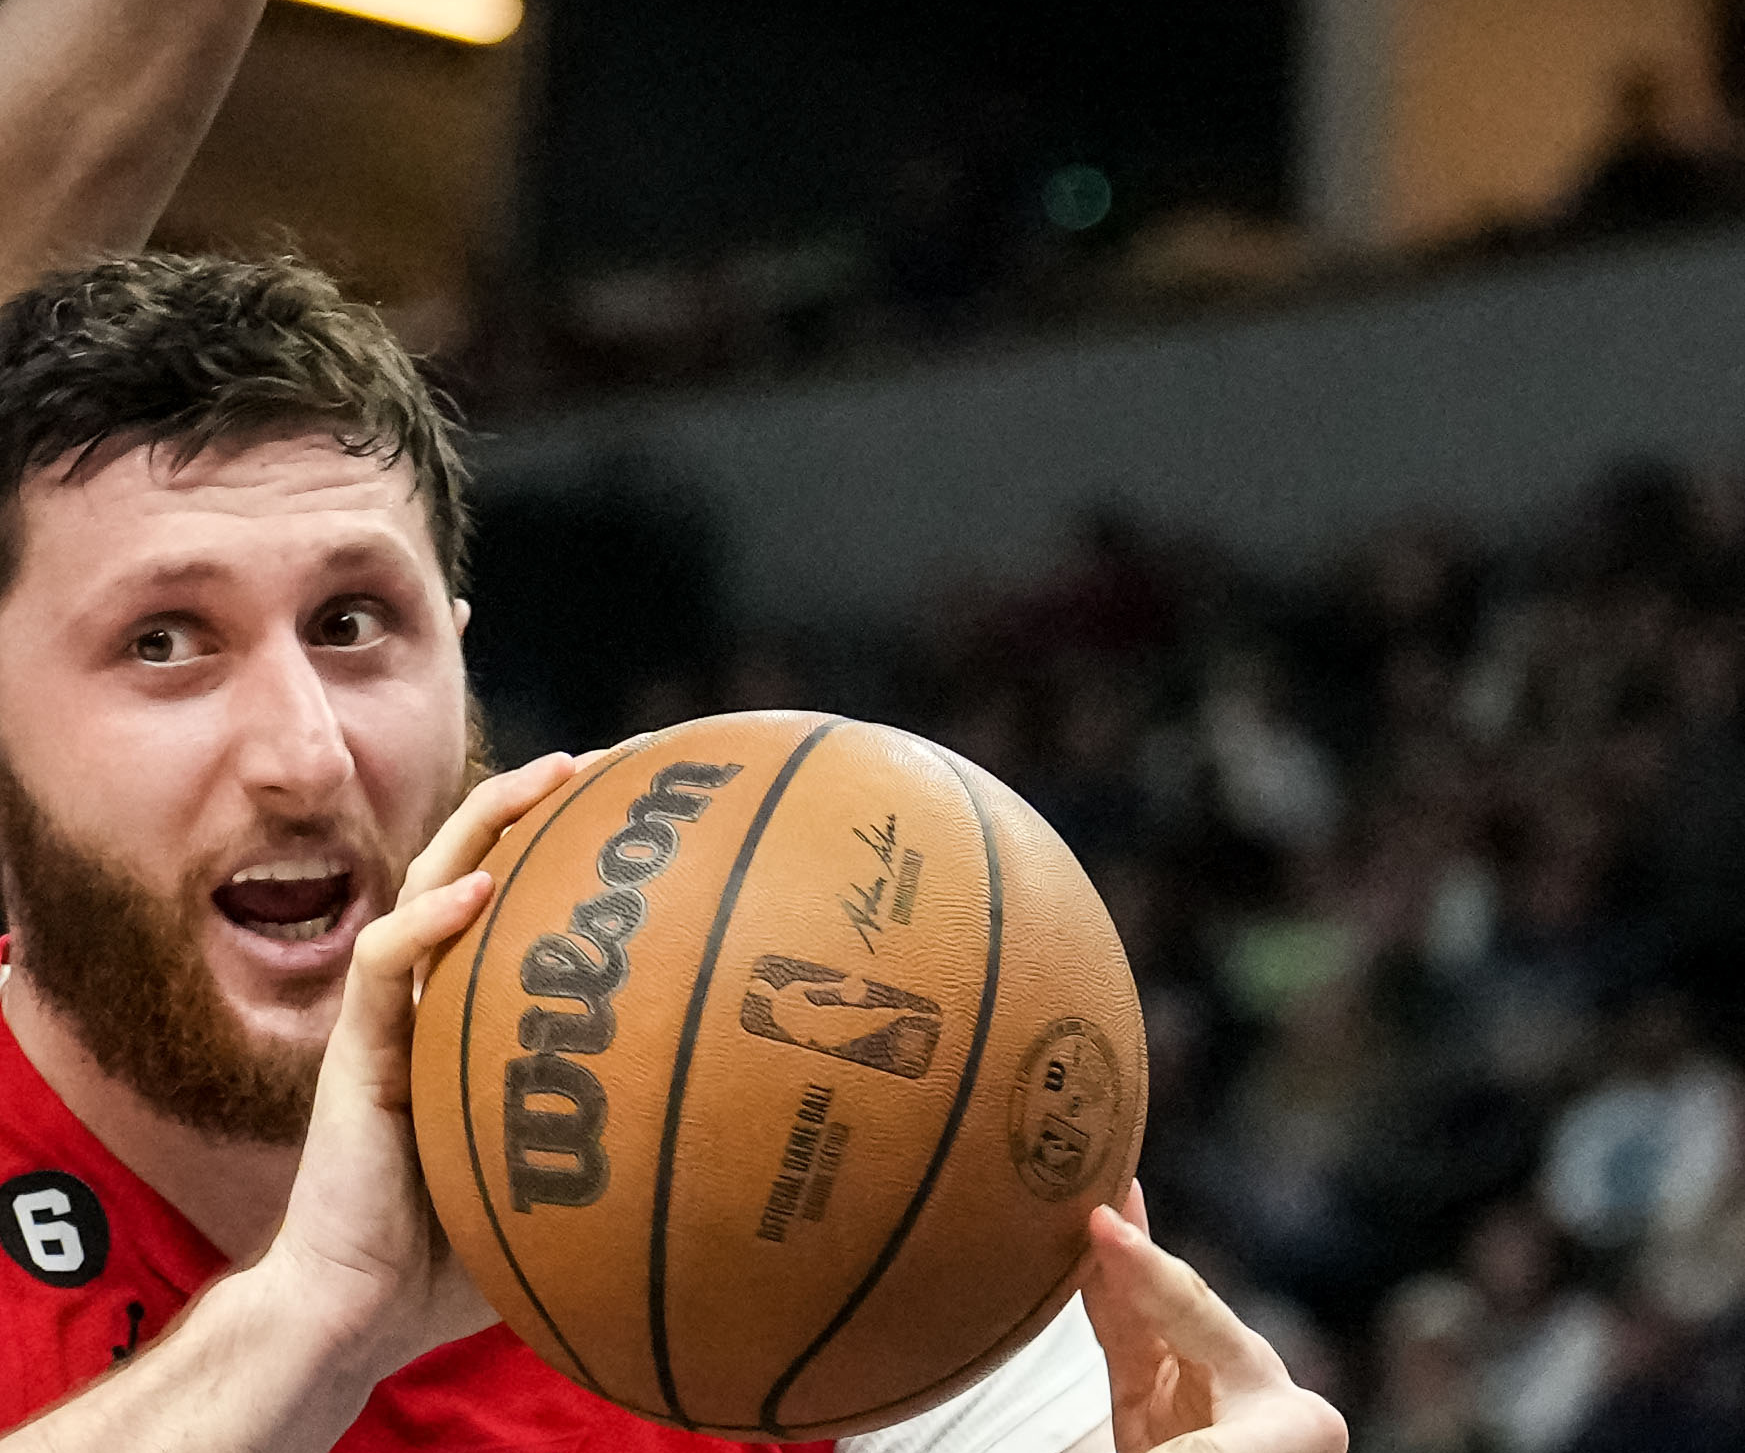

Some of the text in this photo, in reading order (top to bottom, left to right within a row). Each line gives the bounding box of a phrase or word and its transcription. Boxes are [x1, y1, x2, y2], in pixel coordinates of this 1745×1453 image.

[503, 759, 745, 1215] Wilson
[796, 1084, 834, 1124] BALL
[11, 1187, 85, 1272] 6
